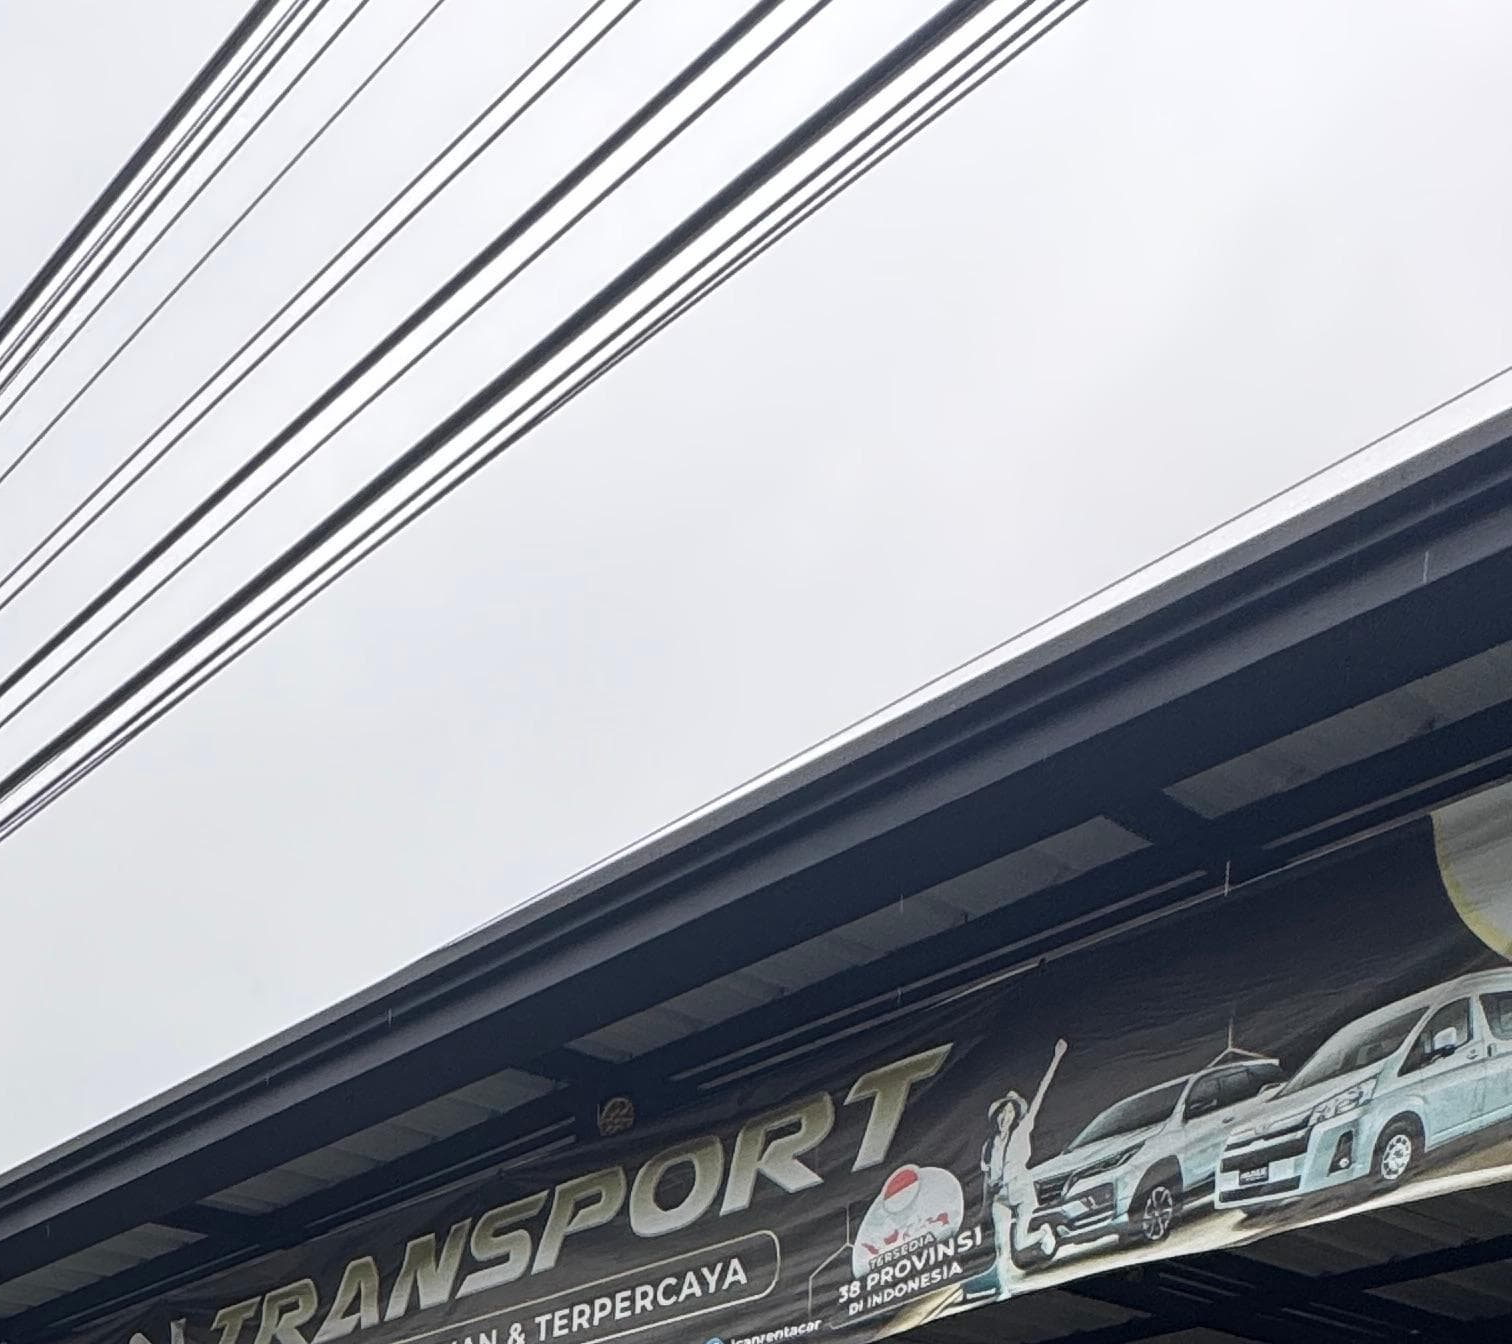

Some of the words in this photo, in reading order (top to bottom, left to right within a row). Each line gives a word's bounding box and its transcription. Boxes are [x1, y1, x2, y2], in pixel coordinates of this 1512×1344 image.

[838, 1280, 861, 1304] 38
[866, 1225, 983, 1292] PROVINSI
[870, 1231, 936, 1270] TERSEDIA
[534, 1257, 748, 1342] TERPERCAYA
[848, 1301, 864, 1316] DI
[867, 1261, 964, 1309] INDONESIA
